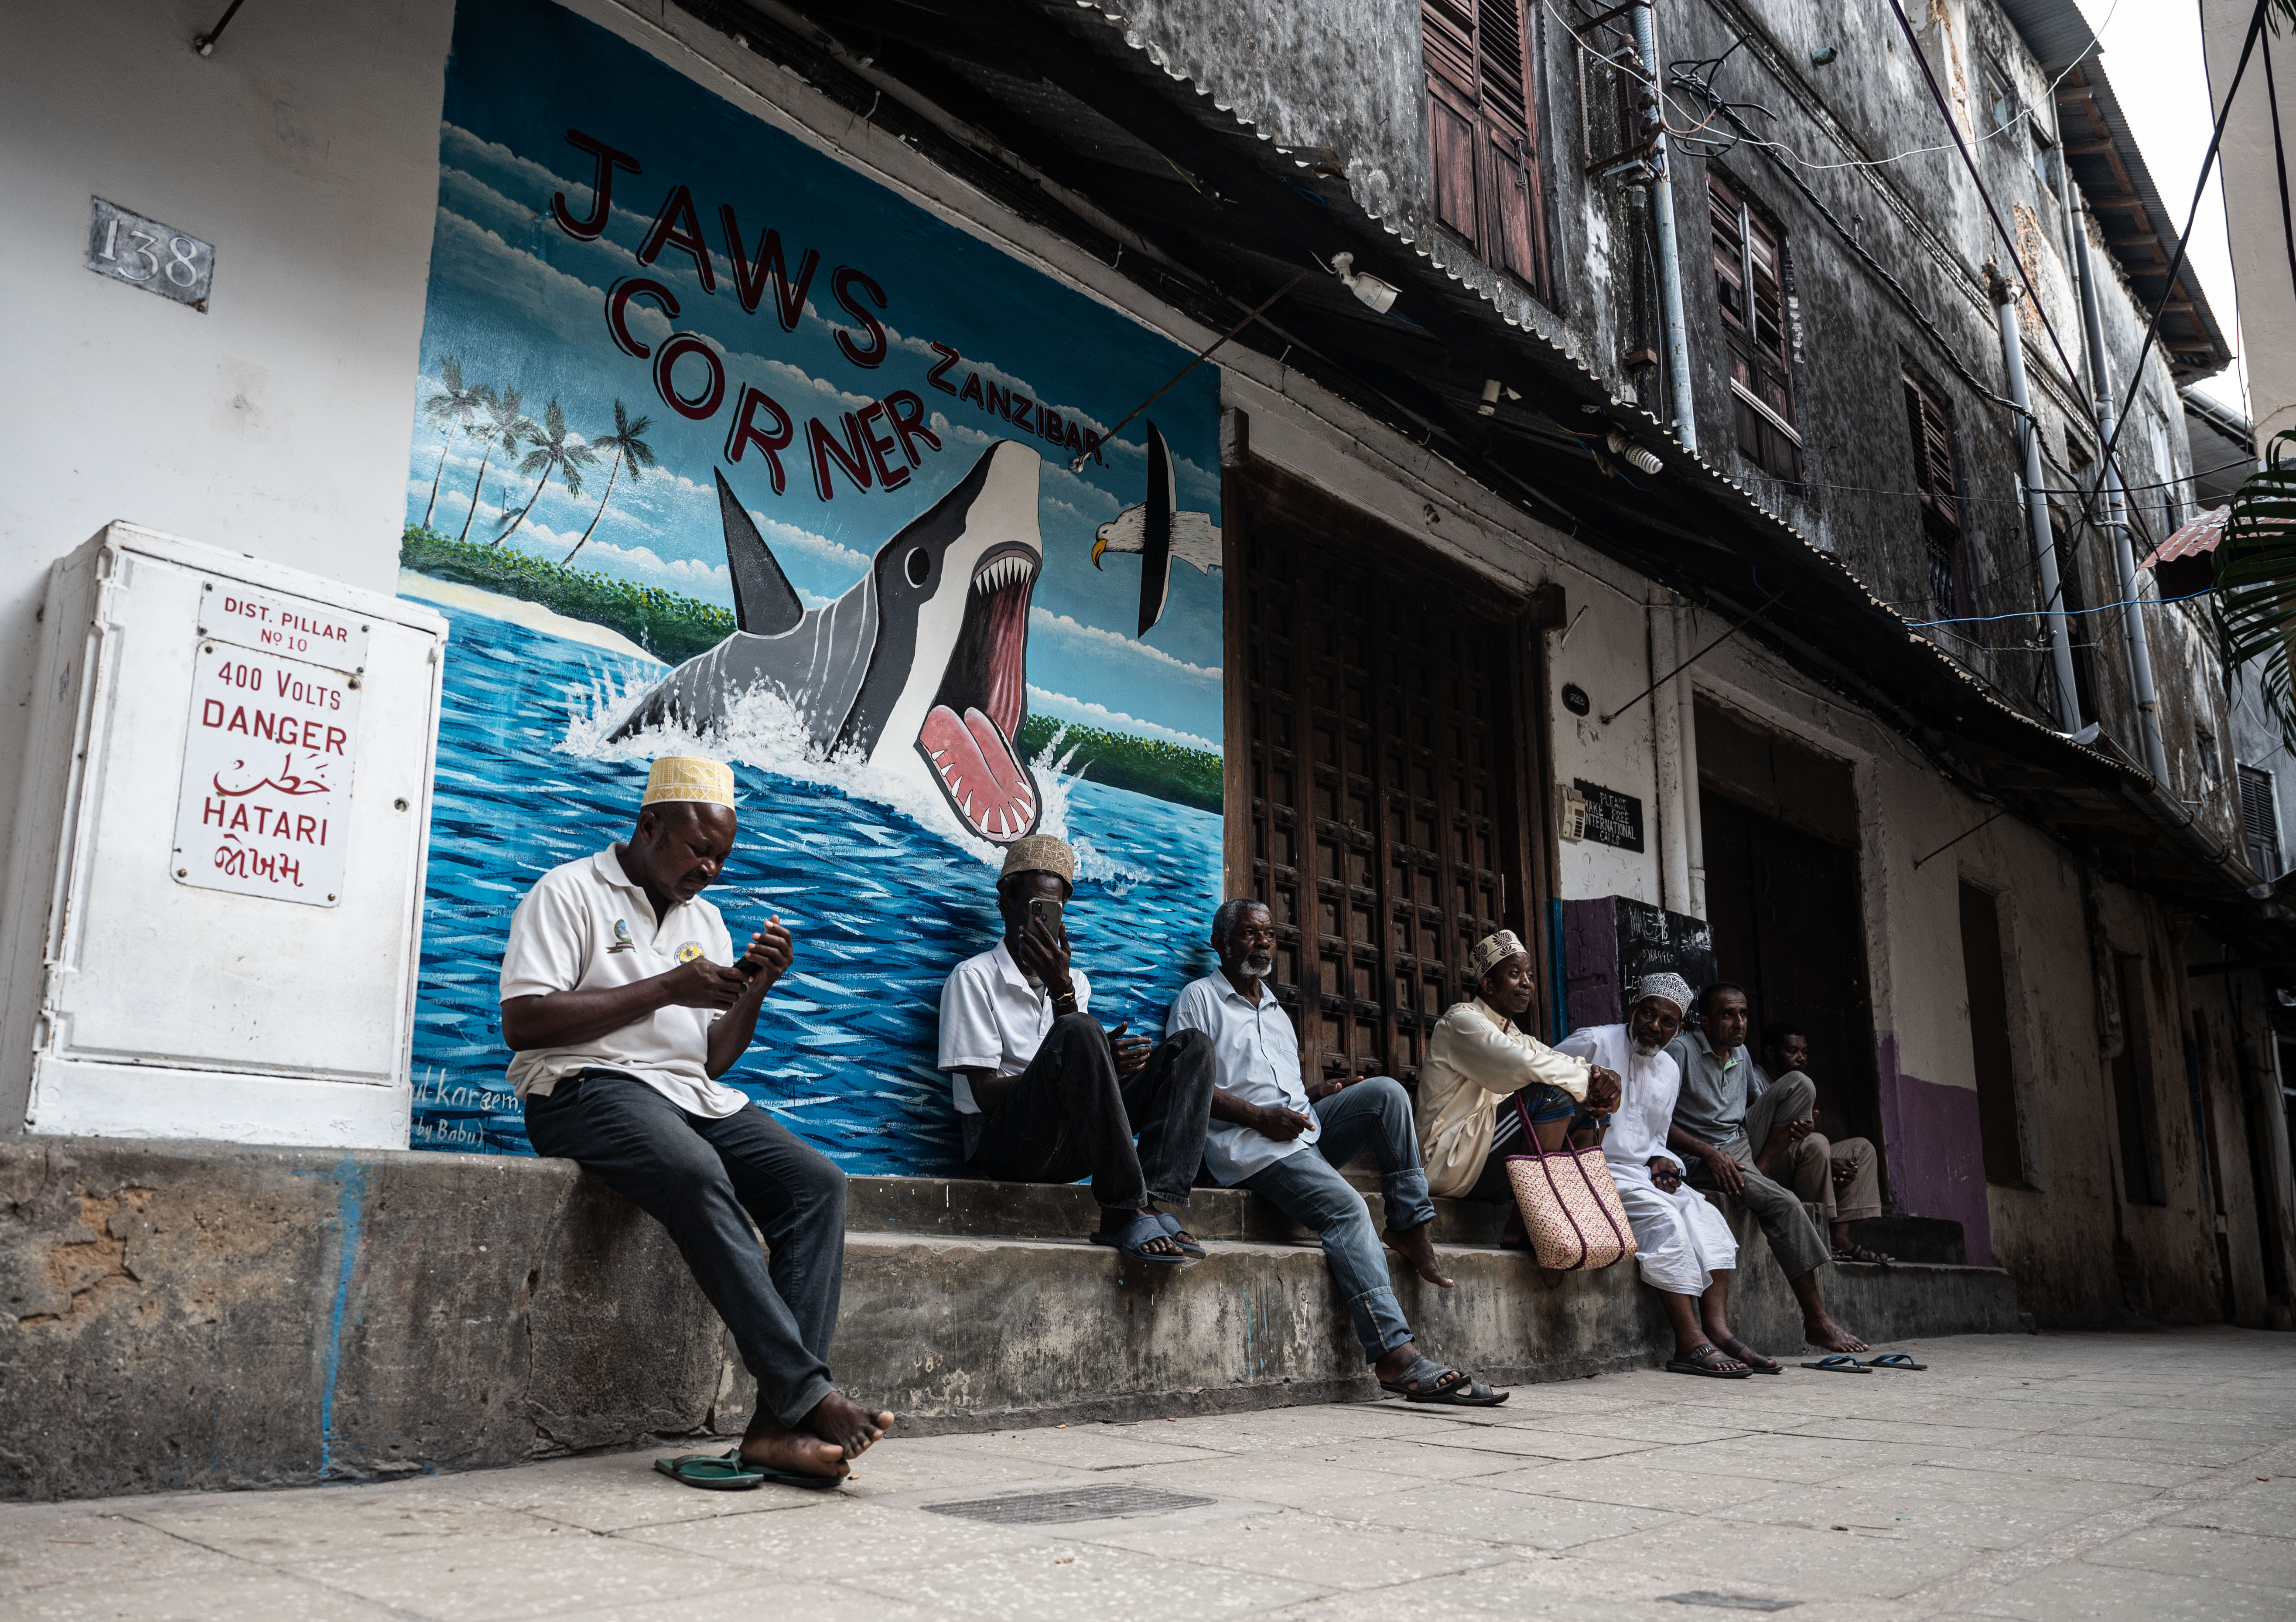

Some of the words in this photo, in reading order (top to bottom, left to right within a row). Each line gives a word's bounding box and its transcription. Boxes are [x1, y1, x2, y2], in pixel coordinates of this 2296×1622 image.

[99, 219, 197, 288] 138
[550, 128, 888, 369] JAWS
[605, 276, 942, 502] CORNER
[224, 597, 272, 623] DIST.
[281, 612, 348, 642] PILLAR
[288, 636, 307, 652] 10
[218, 661, 262, 691] 400
[202, 698, 347, 756] DANGER
[1583, 798, 1604, 817] MAKE
[1611, 808, 1630, 824] FREE
[1599, 792, 1627, 811] PLEASE
[203, 797, 327, 846] HATARI
[1585, 812, 1636, 840] NTERNATIONAL
[1600, 830, 1620, 845] CALLS
